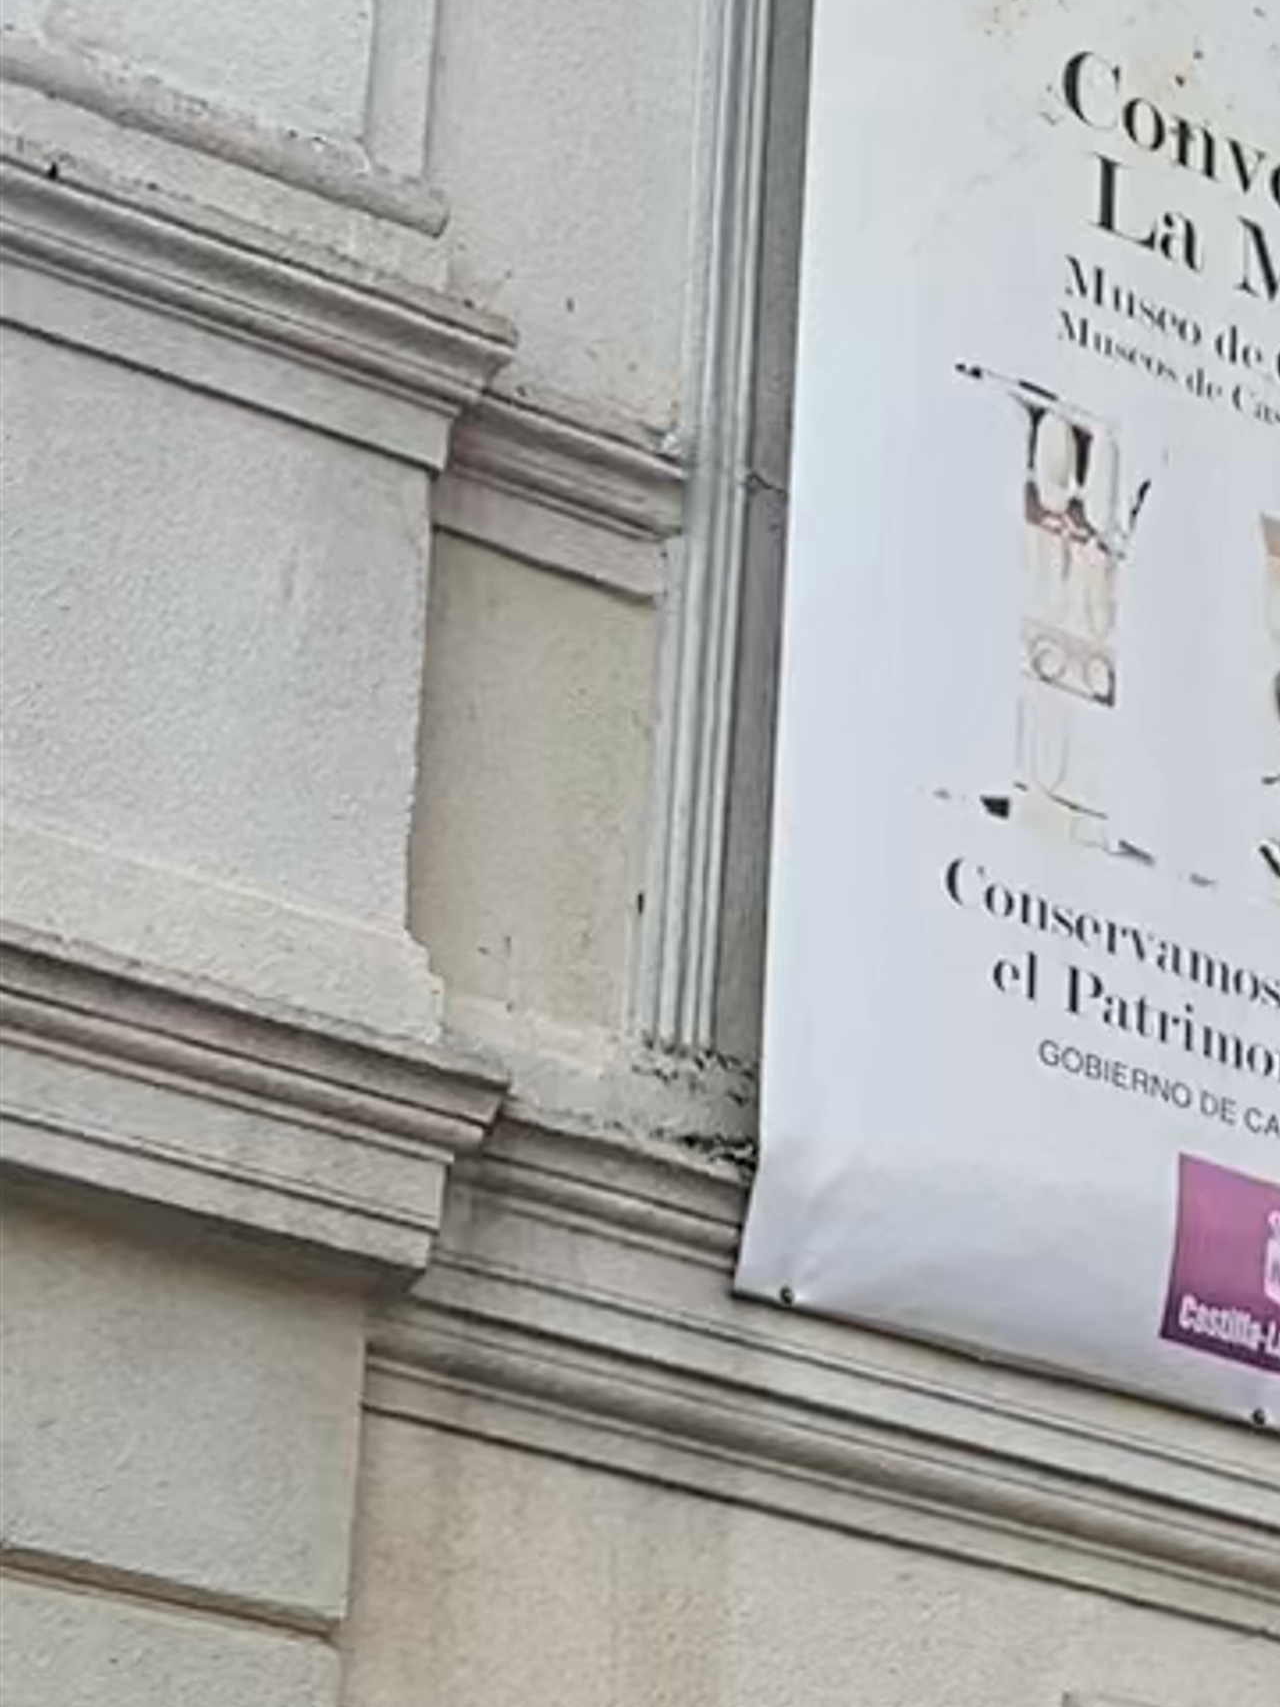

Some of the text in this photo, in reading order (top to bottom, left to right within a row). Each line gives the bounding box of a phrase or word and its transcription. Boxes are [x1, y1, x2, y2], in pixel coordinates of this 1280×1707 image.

[1086, 151, 1202, 272] La
[1058, 309, 1177, 382] Museos
[1185, 368, 1223, 399] de
[1065, 254, 1202, 345] Museo
[1215, 324, 1262, 369] de
[992, 950, 1037, 1002] el
[1038, 1039, 1192, 1109] GOBIERNO
[1200, 1090, 1237, 1126] DE
